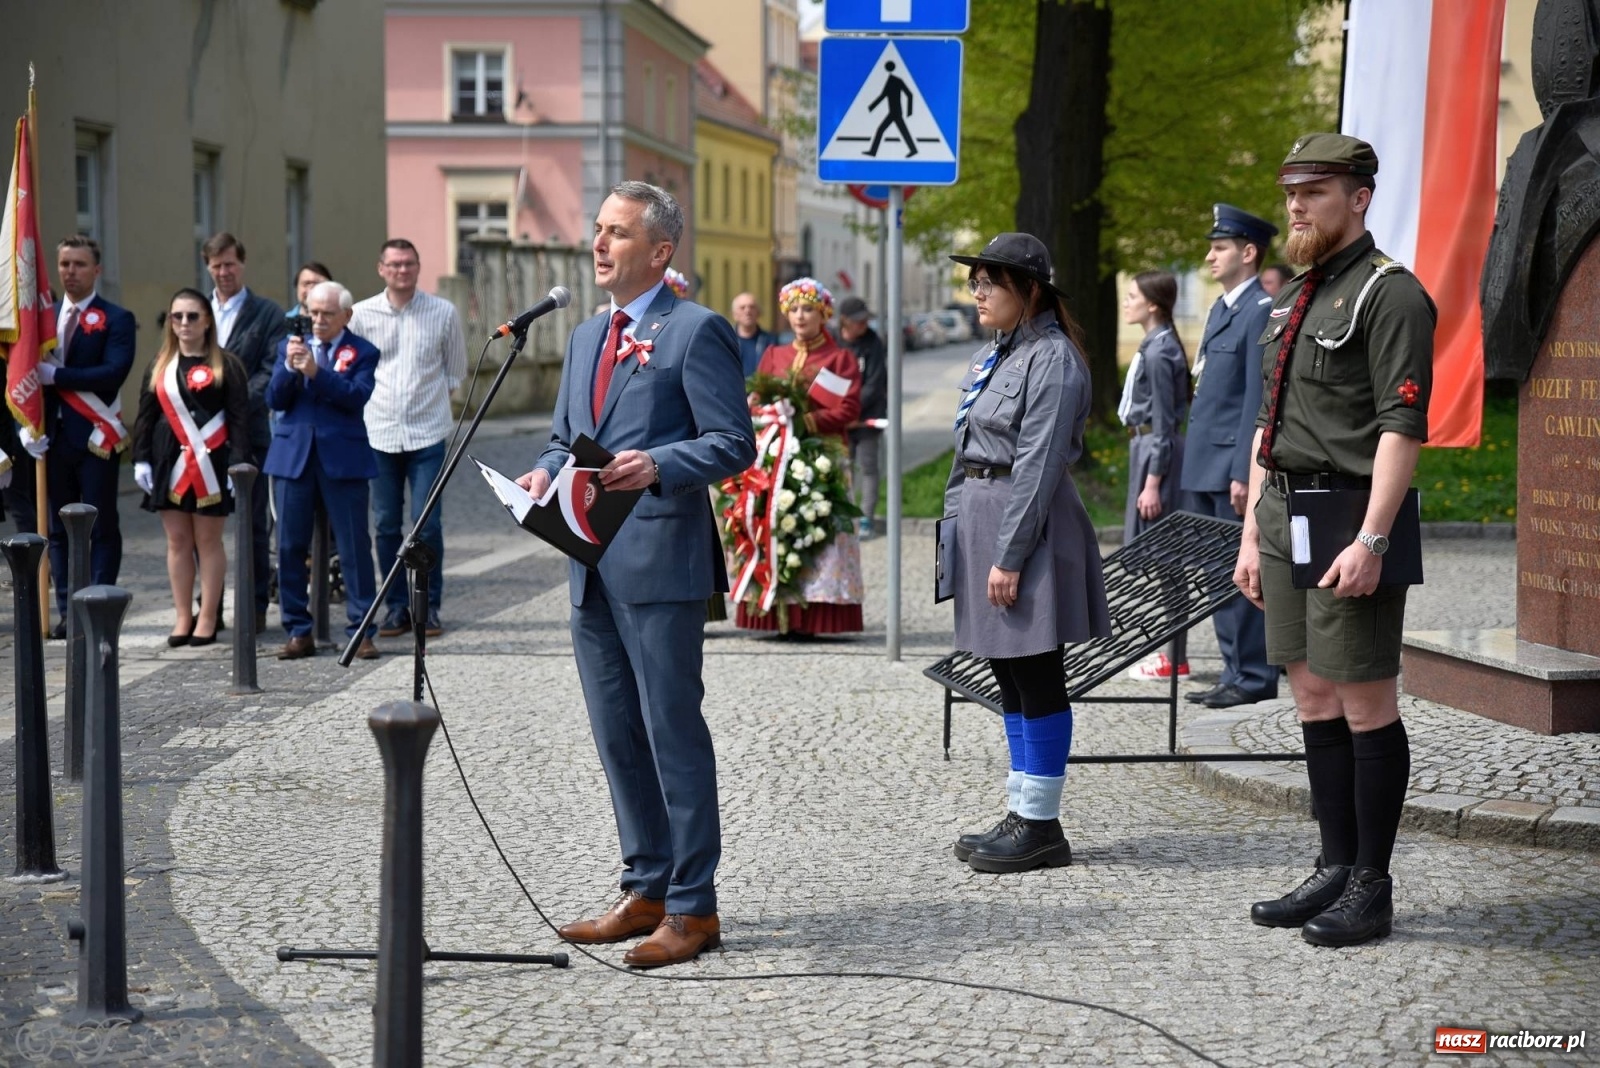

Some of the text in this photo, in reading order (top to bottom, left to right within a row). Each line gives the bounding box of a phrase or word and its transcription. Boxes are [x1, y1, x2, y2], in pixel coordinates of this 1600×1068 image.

[1581, 379, 1600, 400] FE
[1532, 489, 1570, 508] BISKUP
[1530, 517, 1600, 541] WOJSK POLS
